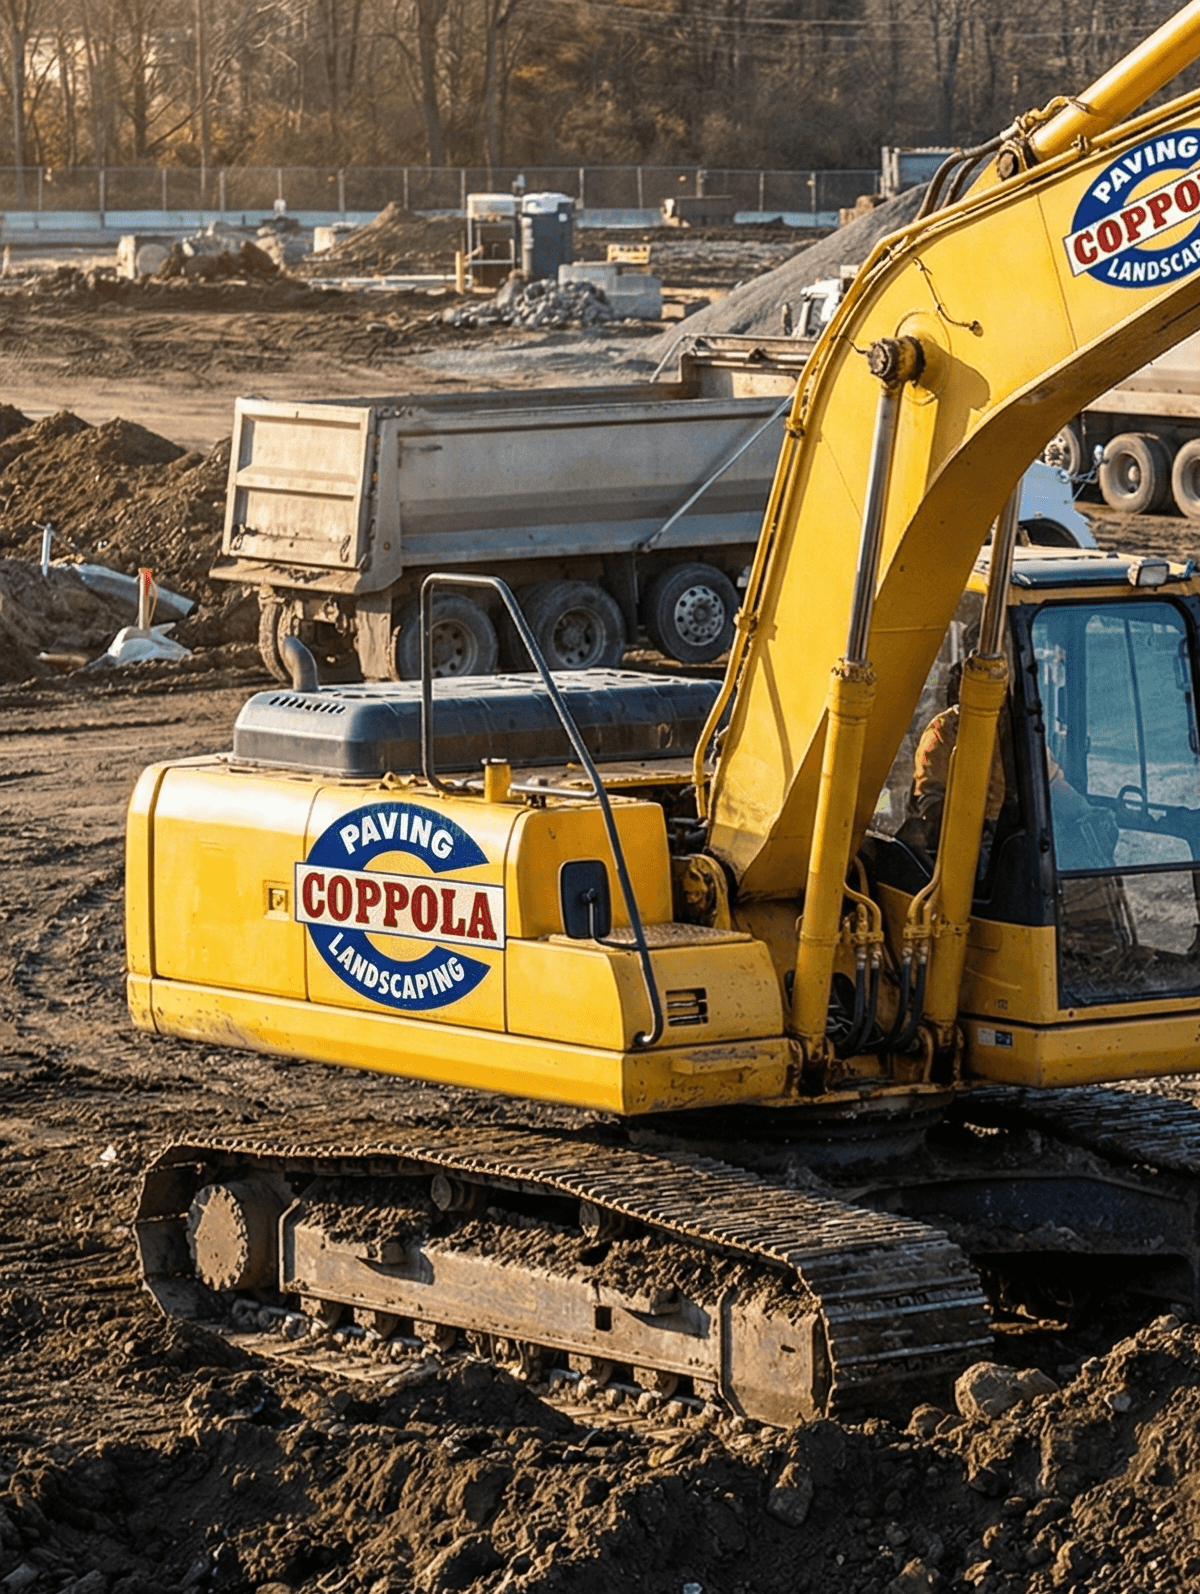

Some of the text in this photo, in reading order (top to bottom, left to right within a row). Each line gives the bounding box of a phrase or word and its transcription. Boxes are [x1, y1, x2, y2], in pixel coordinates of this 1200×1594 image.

[1092, 136, 1199, 204] PAVING
[339, 812, 454, 859] PAVING
[302, 872, 497, 940] COPPOLA
[328, 932, 465, 999] LANDSCAPING
